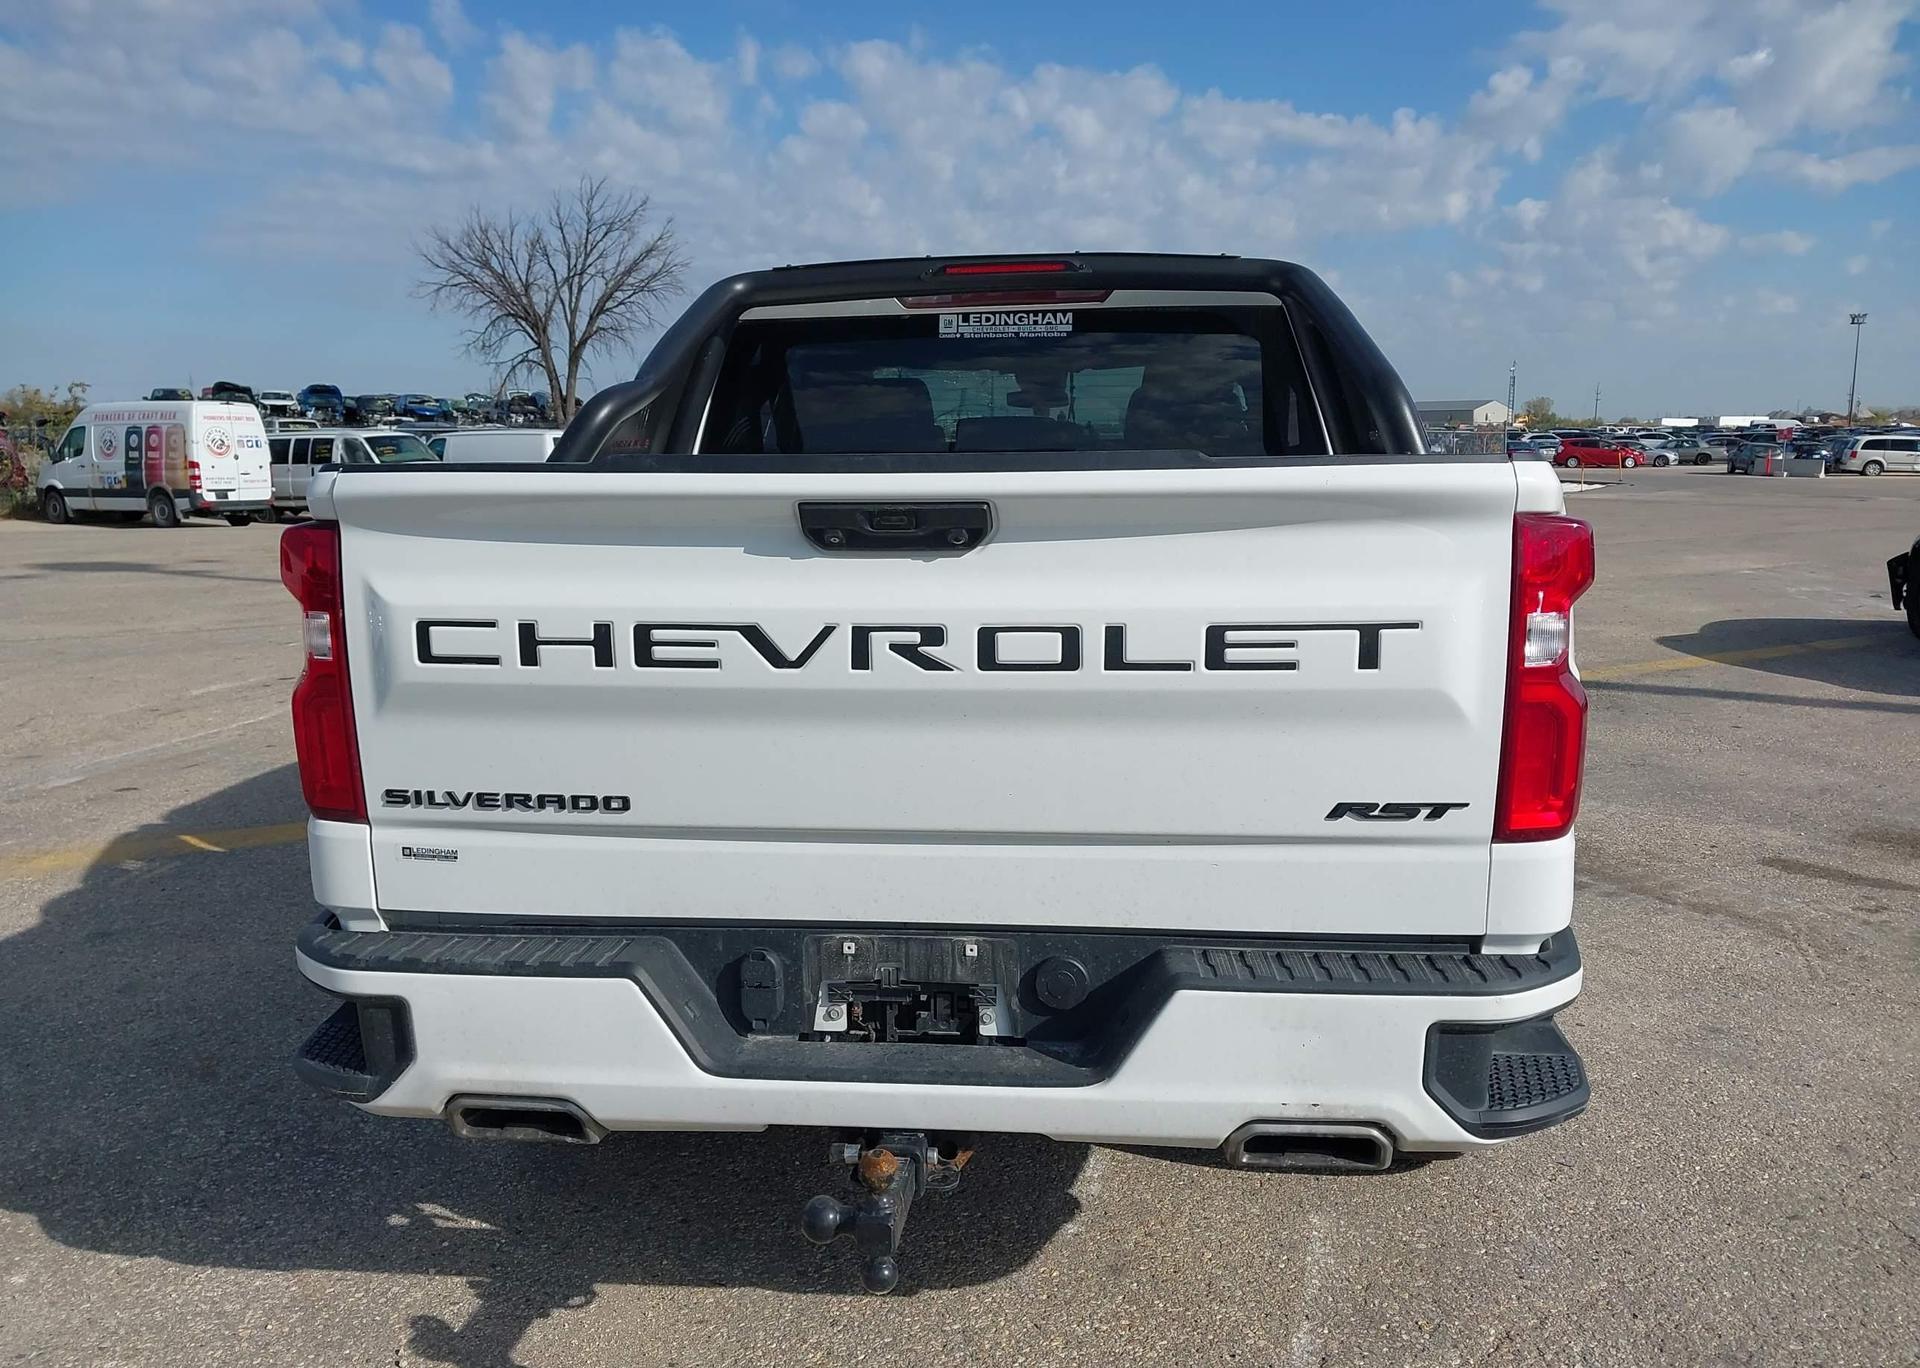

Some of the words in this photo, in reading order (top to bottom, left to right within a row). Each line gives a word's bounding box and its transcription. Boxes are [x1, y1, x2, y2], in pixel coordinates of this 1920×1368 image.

[958, 312, 1073, 326] LEDINGHAM
[137, 410, 159, 420] CRAFT
[415, 619, 1422, 671] CHEVROLET
[382, 788, 631, 814] SILVERADO
[1324, 802, 1470, 821] RST
[412, 847, 458, 855] LEDINGHAM
